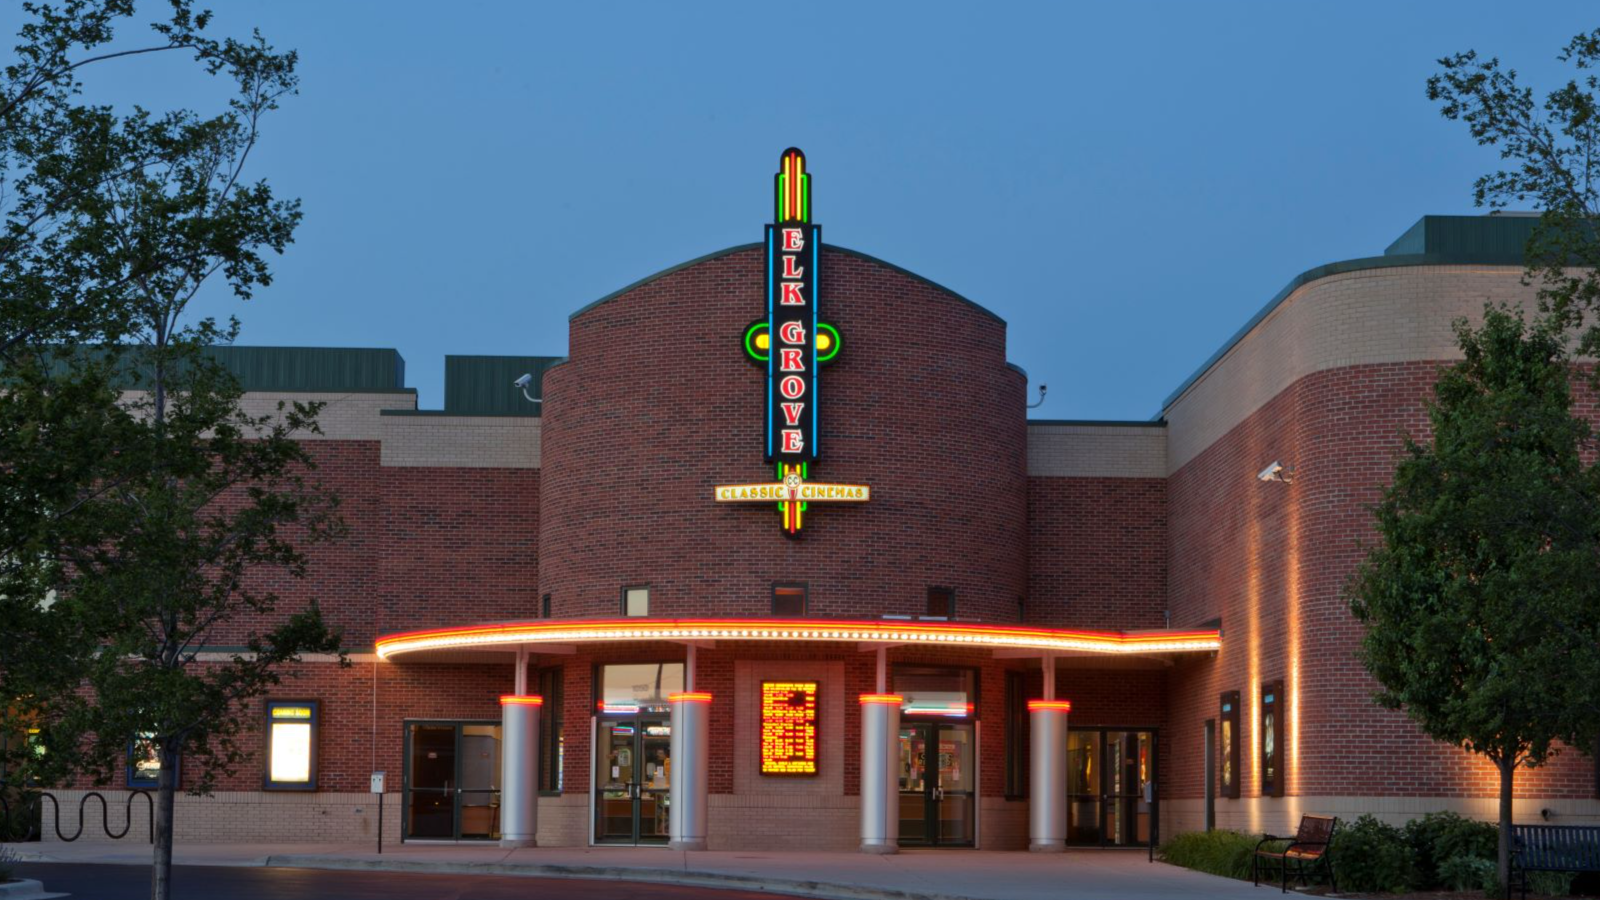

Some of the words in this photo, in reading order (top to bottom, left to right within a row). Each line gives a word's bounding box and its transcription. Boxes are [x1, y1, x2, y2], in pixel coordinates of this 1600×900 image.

[780, 228, 806, 306] ELK
[779, 320, 806, 454] GROVE
[720, 486, 784, 499] CLASSIC
[801, 486, 864, 499] CINEMAS
